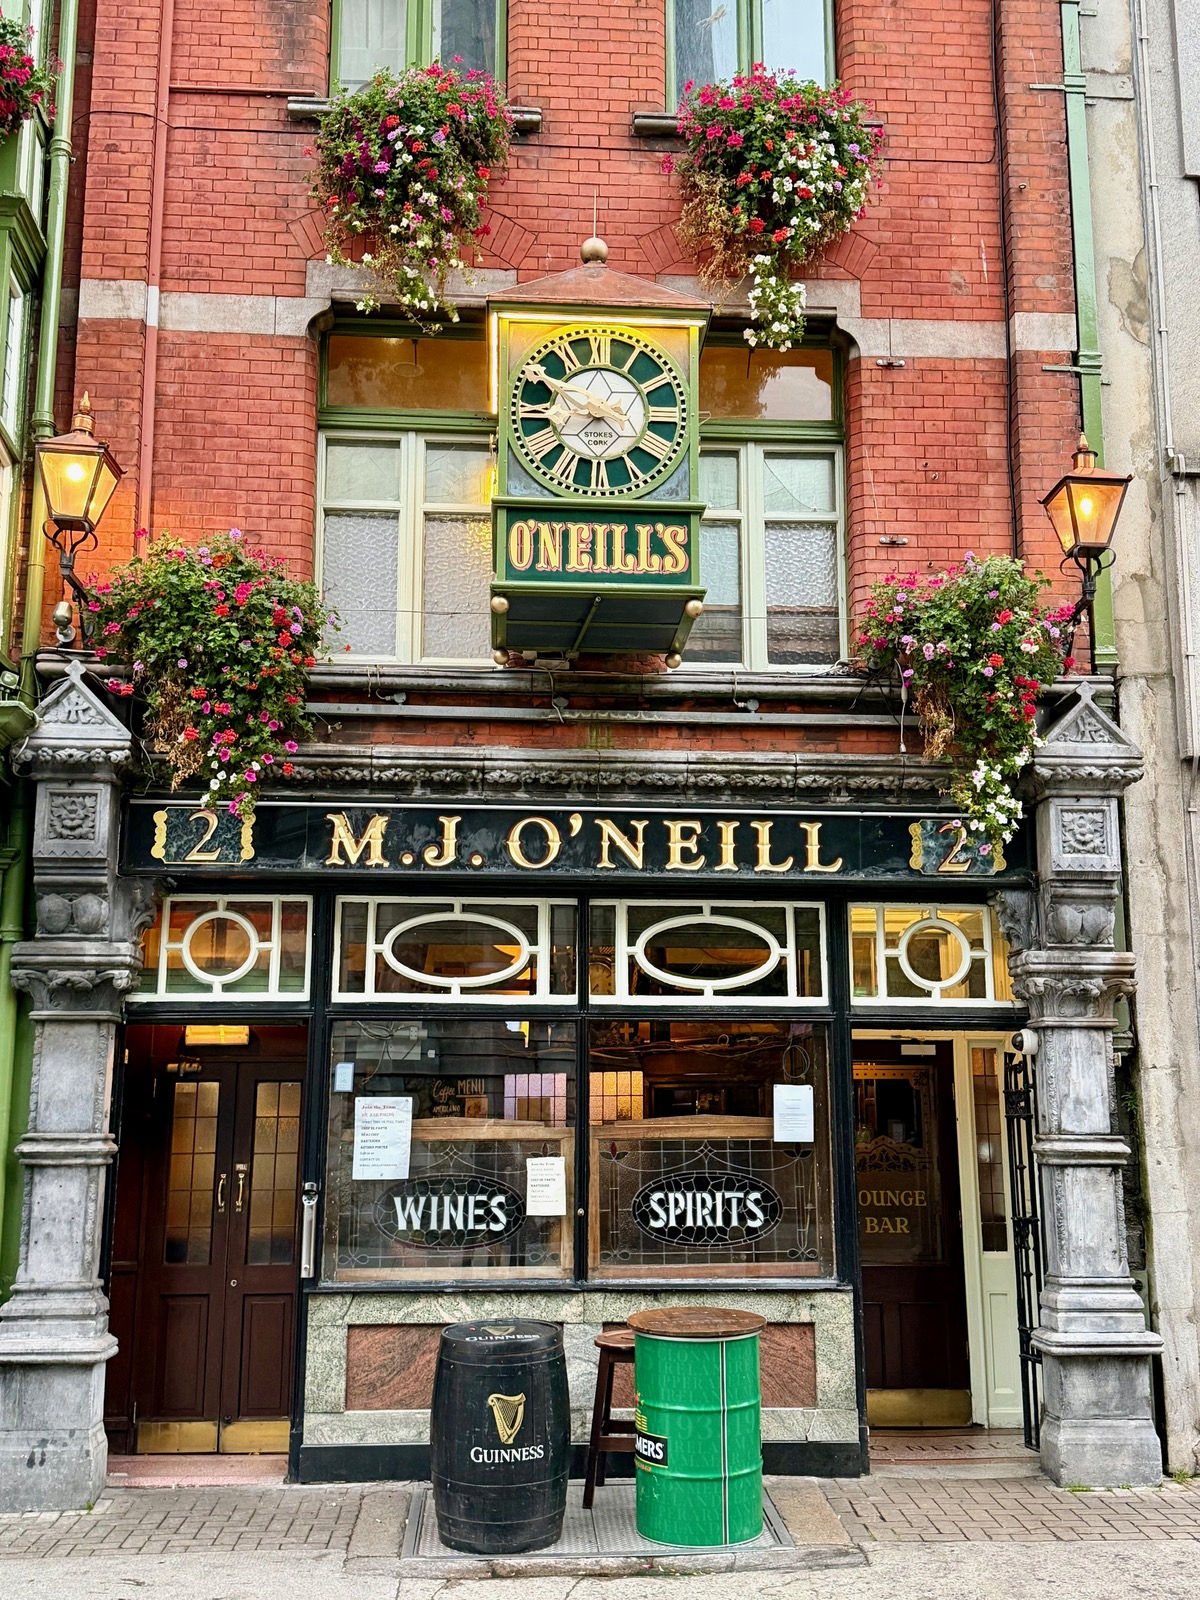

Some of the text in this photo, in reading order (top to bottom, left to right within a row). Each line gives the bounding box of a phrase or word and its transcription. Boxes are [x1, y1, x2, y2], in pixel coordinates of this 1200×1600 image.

[584, 431, 613, 439] STOKES
[509, 518, 690, 574] O'NEILL'S
[184, 810, 223, 861] 2
[938, 822, 972, 873] 2
[457, 1078, 486, 1095] MENU
[859, 1189, 927, 1208] OUNGE
[393, 1194, 507, 1232] WINES
[649, 1190, 765, 1228] SPIRITS
[865, 1217, 909, 1234] BAR
[465, 1334, 541, 1342] GUINNESS
[470, 1445, 544, 1463] GUINNESS
